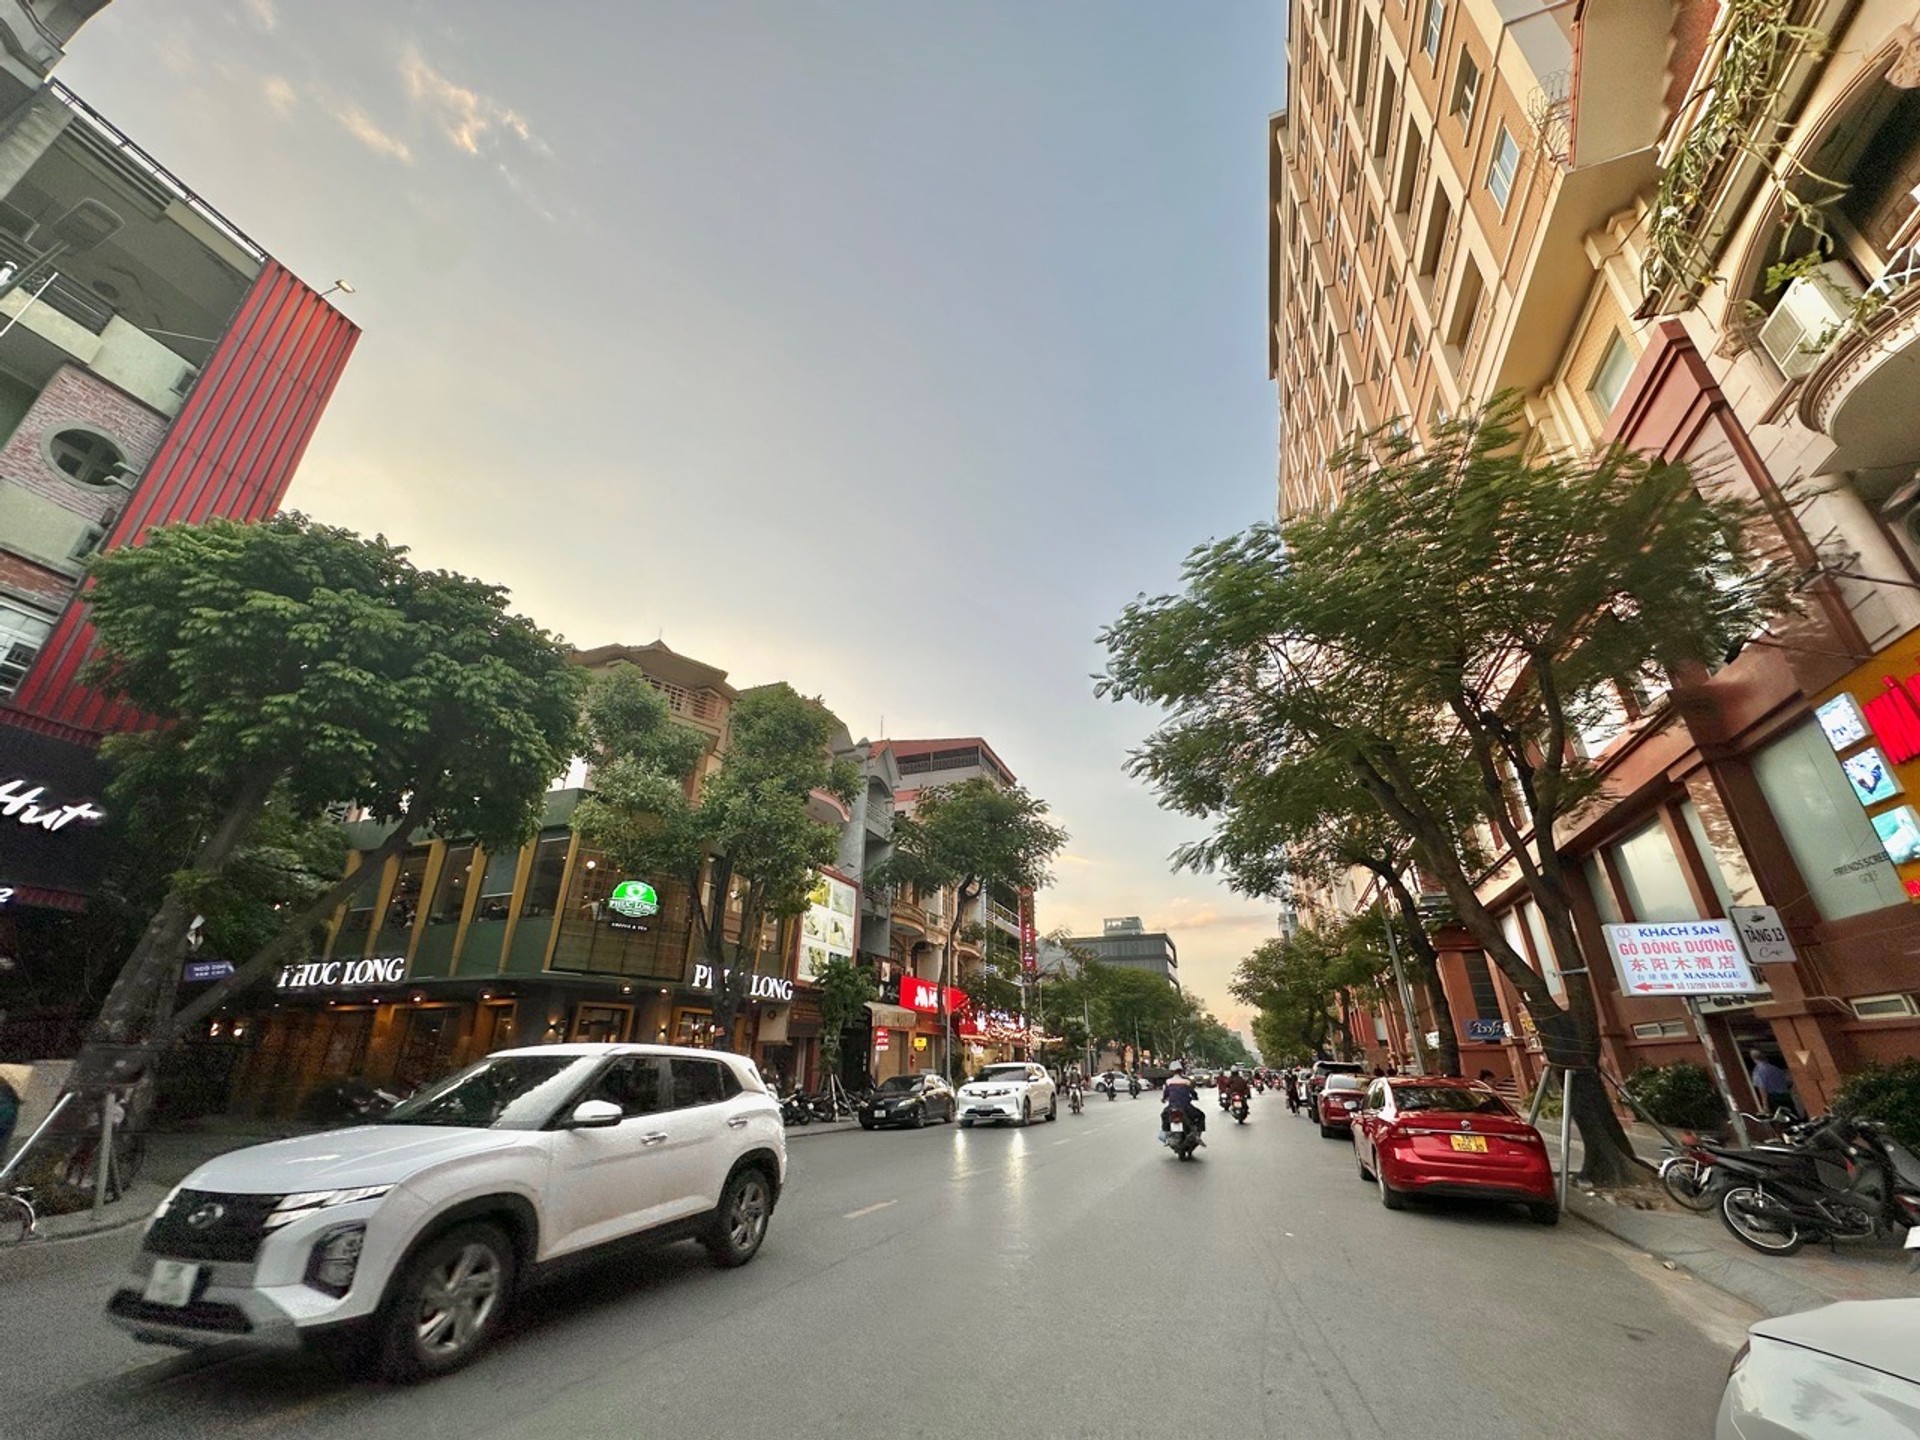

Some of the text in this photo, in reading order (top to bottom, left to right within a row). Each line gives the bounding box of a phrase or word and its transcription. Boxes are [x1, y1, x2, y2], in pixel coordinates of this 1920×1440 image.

[0, 779, 104, 831] Hut
[1771, 927, 1785, 942] 13
[341, 958, 405, 985] LONG
[1684, 971, 1740, 980] MASSAGE
[750, 975, 794, 1000] LONG
